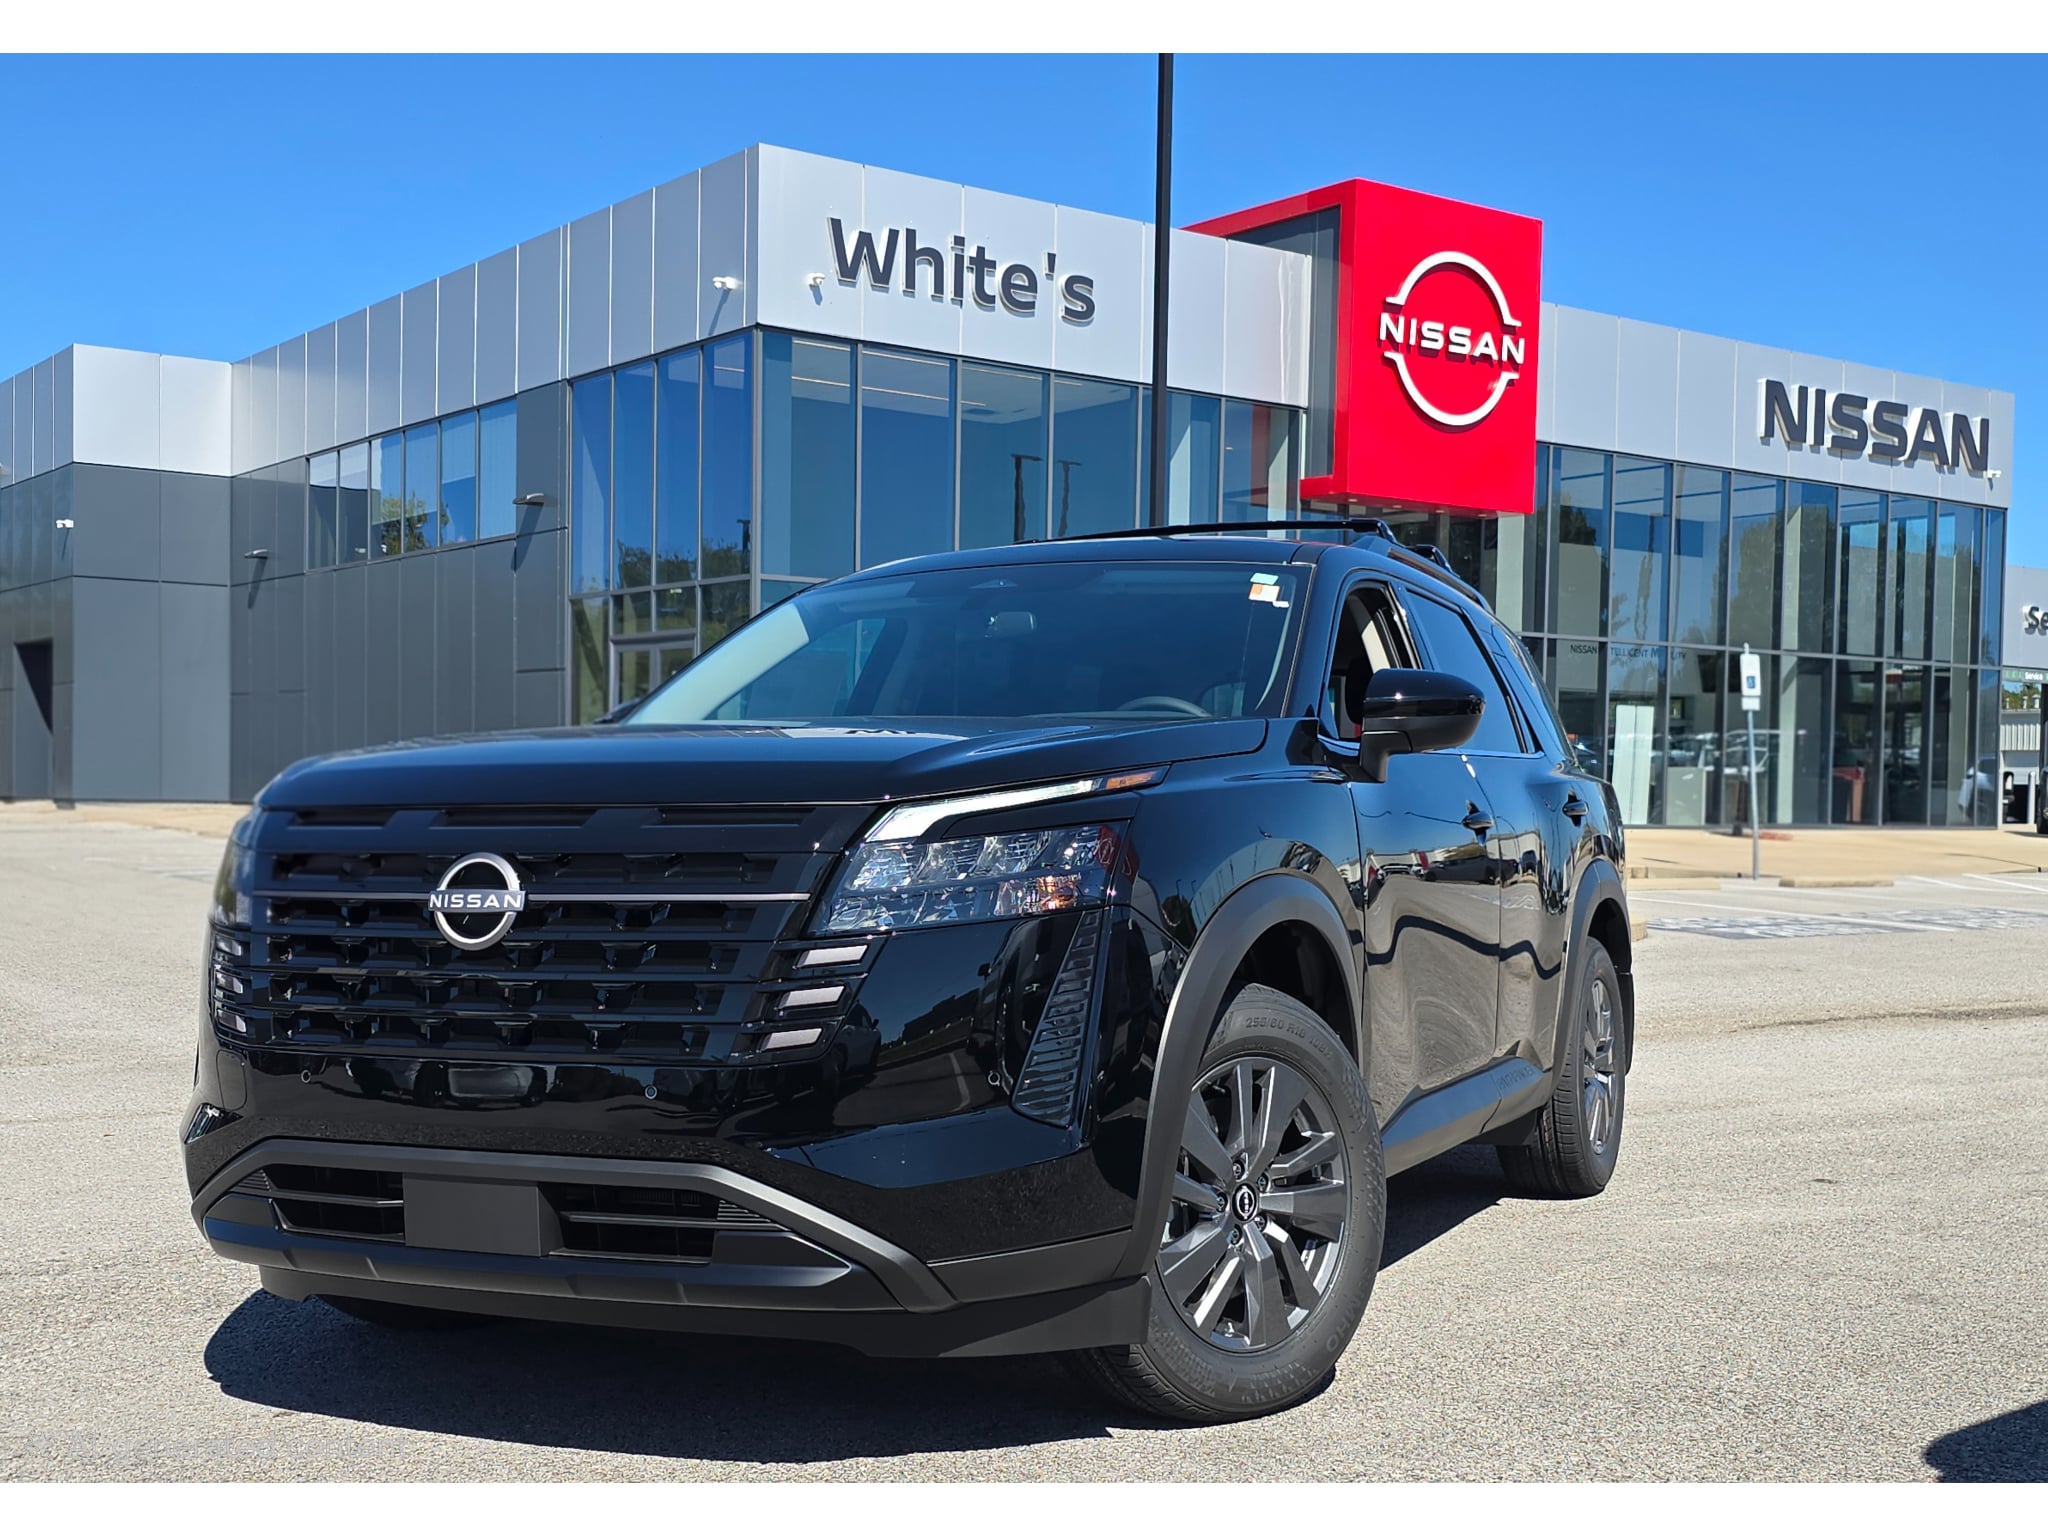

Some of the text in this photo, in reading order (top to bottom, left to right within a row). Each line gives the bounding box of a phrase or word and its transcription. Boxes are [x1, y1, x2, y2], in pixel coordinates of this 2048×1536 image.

[828, 217, 1096, 322] White's
[1380, 312, 1525, 364] NISSAN
[1758, 378, 1990, 472] NISSAN
[429, 894, 521, 908] NISSAN
